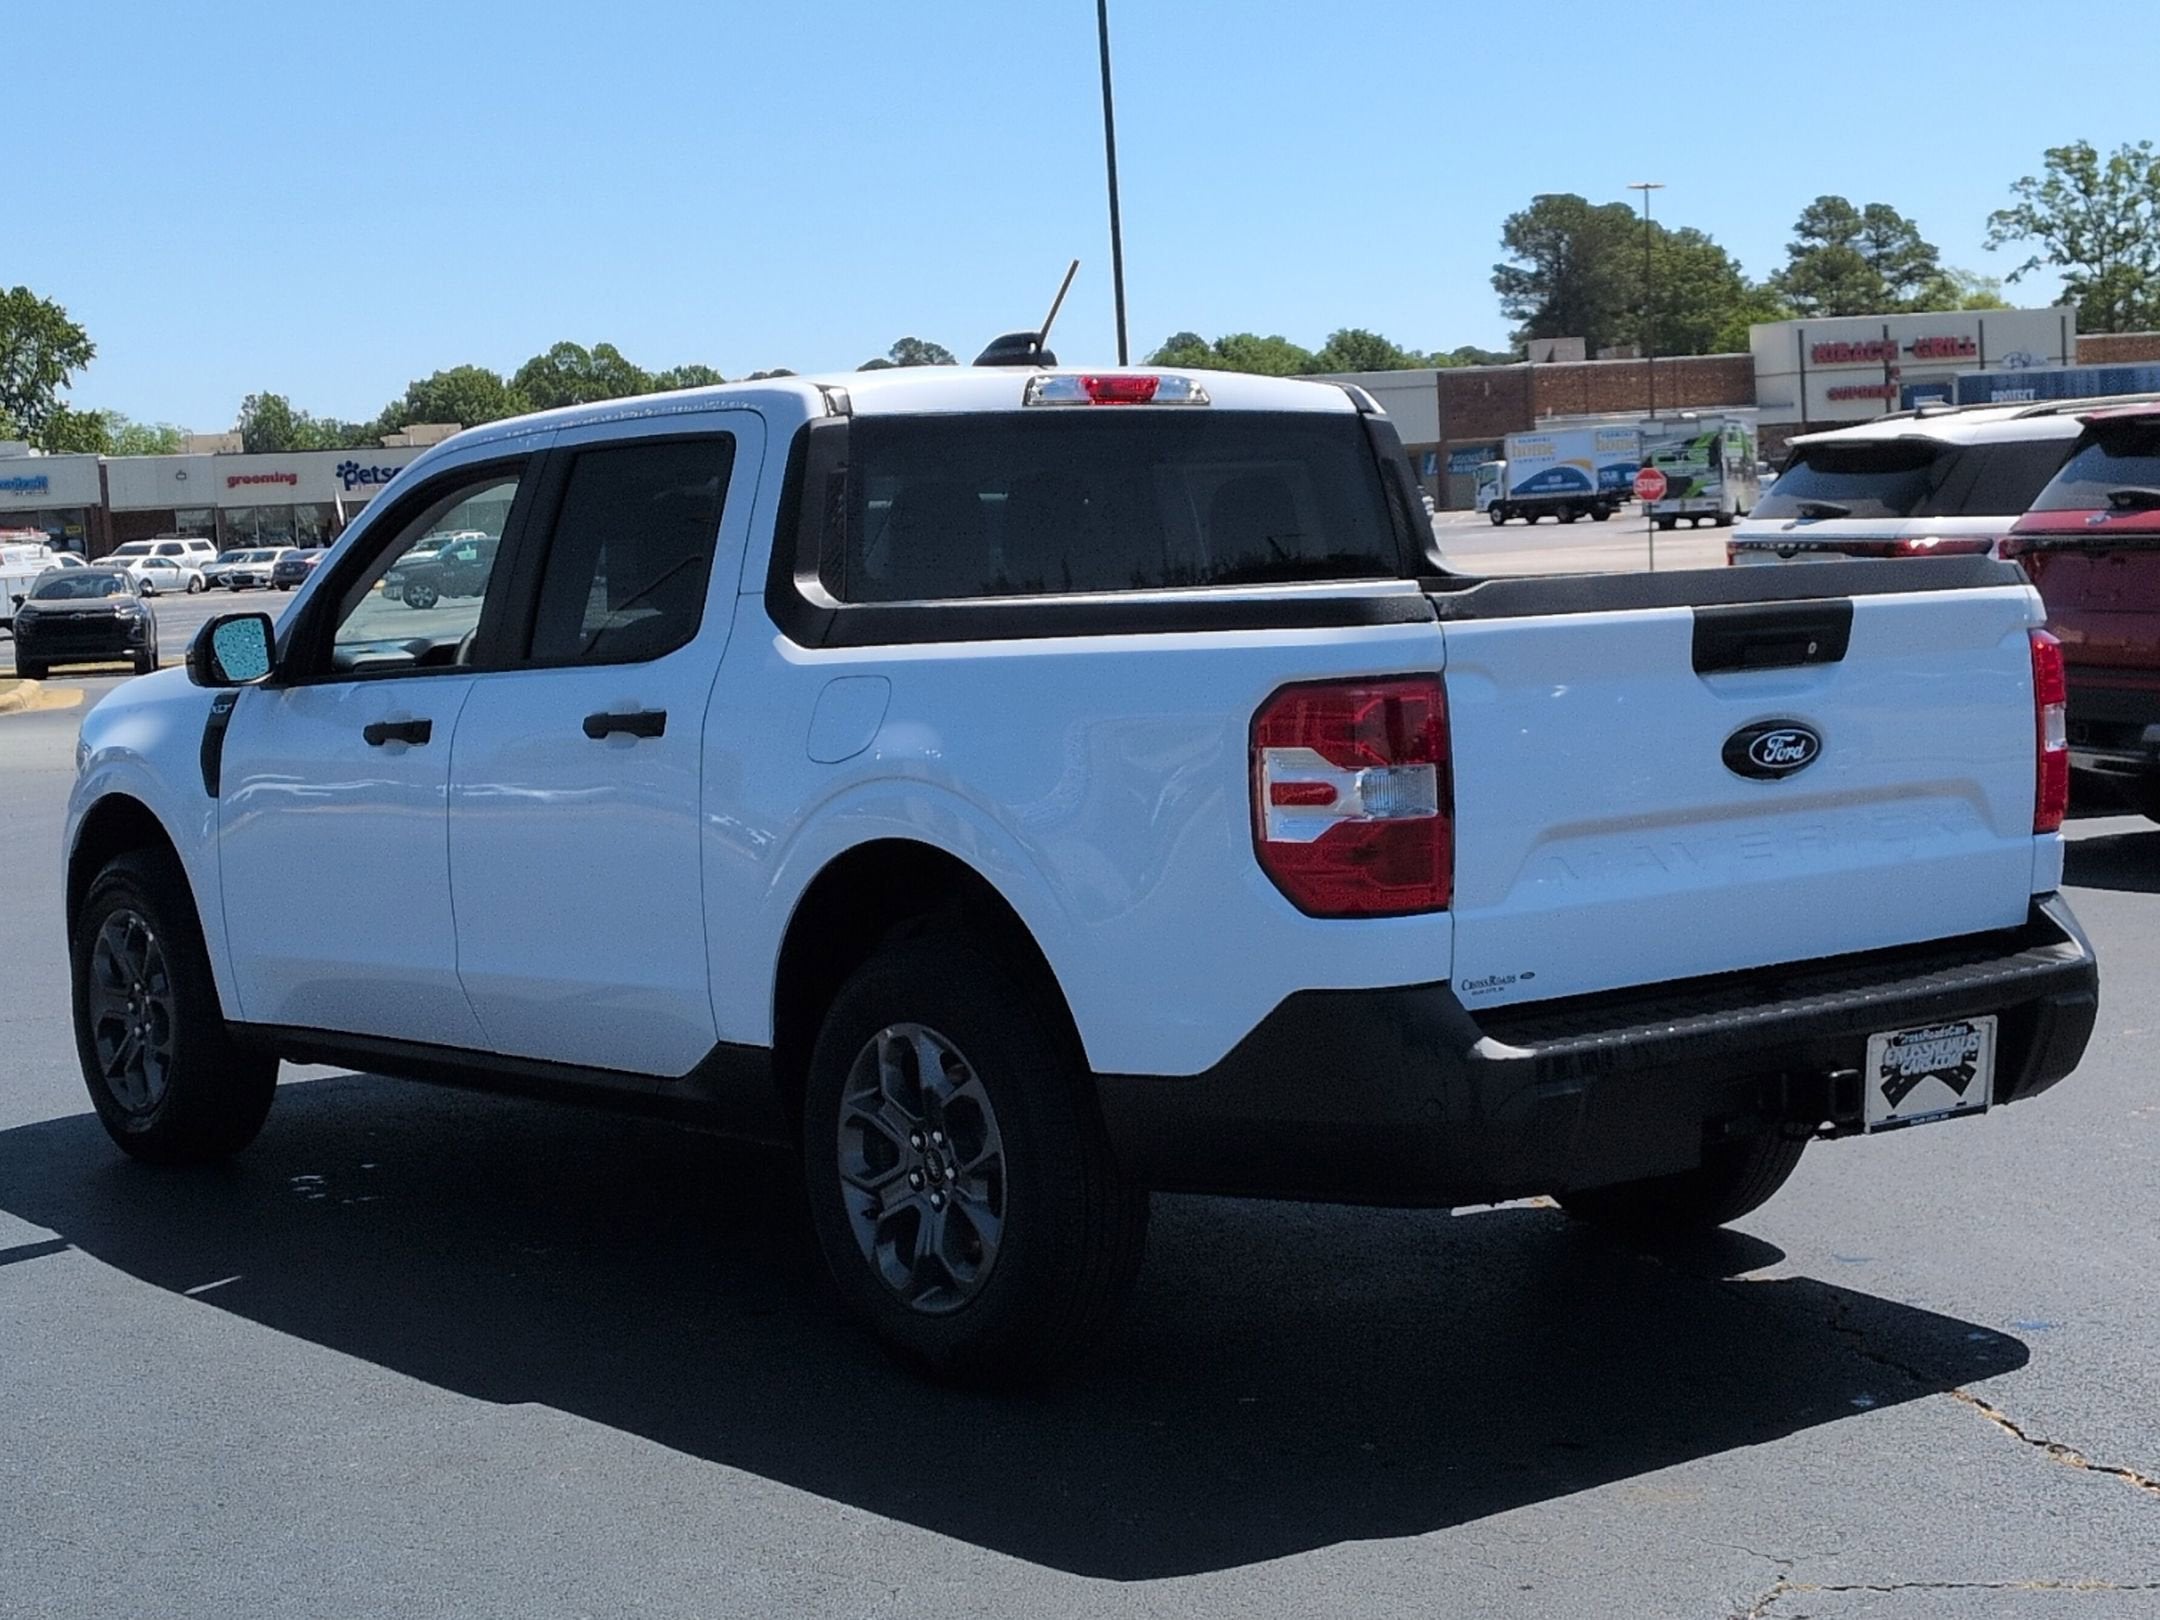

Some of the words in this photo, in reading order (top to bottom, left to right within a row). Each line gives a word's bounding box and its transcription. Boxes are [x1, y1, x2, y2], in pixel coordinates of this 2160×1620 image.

[227, 472, 297, 488] grooming
[1637, 480, 1664, 491] STOP
[1764, 735, 1806, 762] Ford
